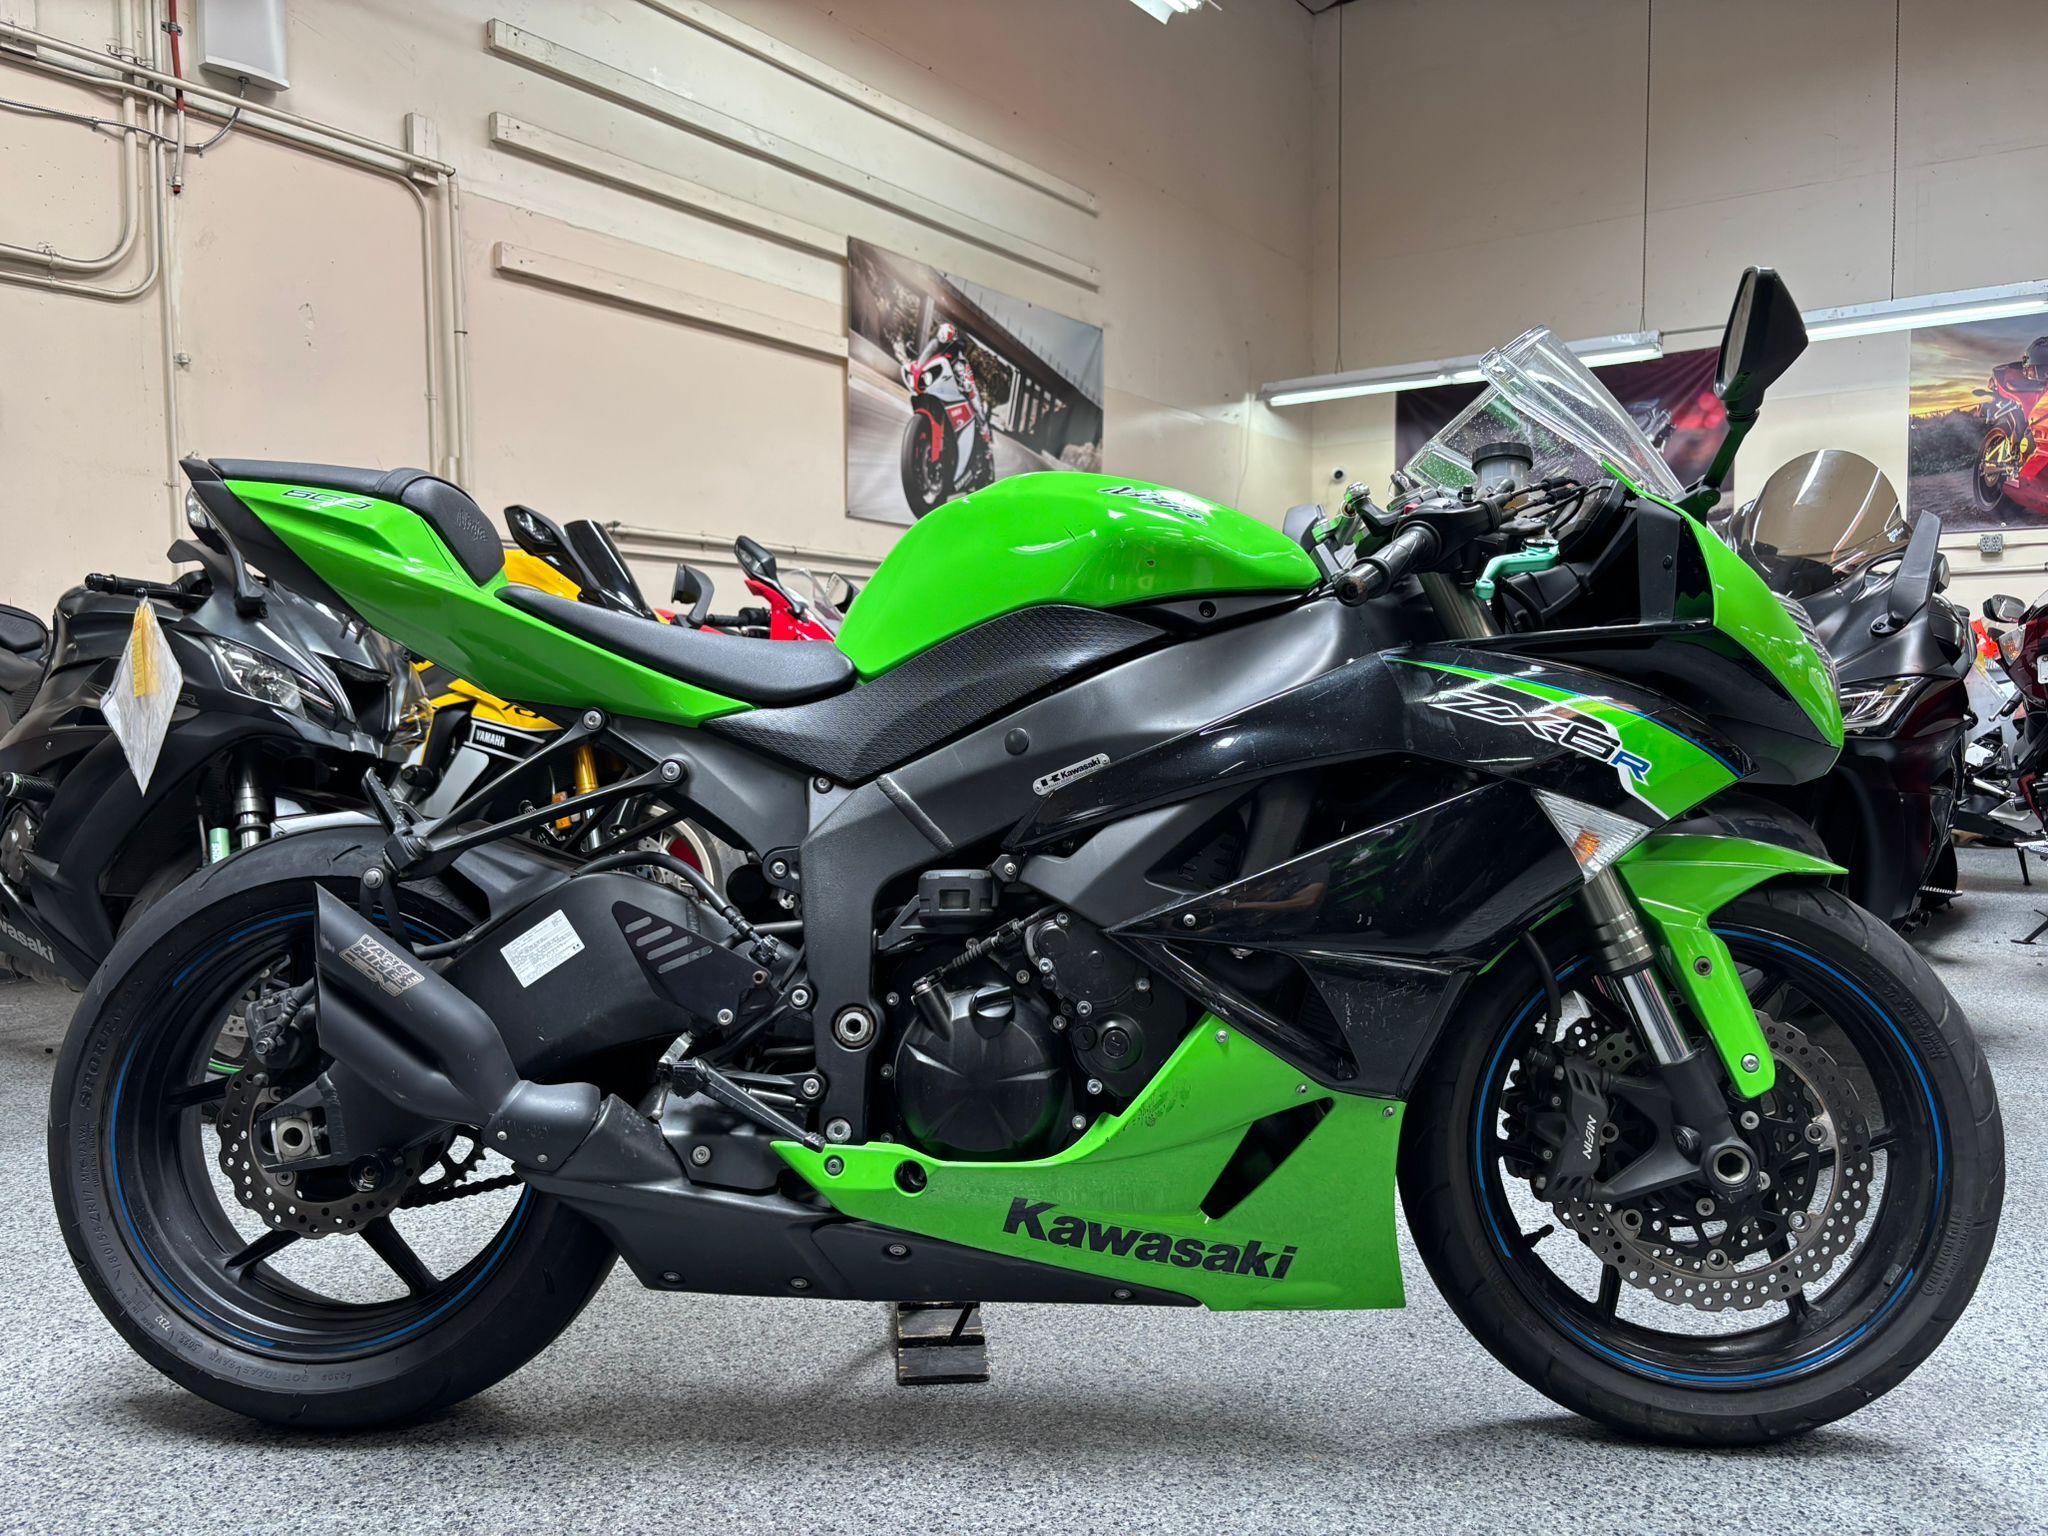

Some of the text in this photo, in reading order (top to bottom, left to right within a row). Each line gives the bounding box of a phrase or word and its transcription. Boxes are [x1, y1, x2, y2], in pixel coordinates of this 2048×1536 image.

[476, 729, 506, 748] YAMAHA
[1060, 756, 1101, 780] Kawasaki
[352, 945, 409, 985] HINES
[361, 937, 420, 982] VANCE
[1002, 1196, 1298, 1279] Kawasaki
[154, 1314, 173, 1332] 7232
